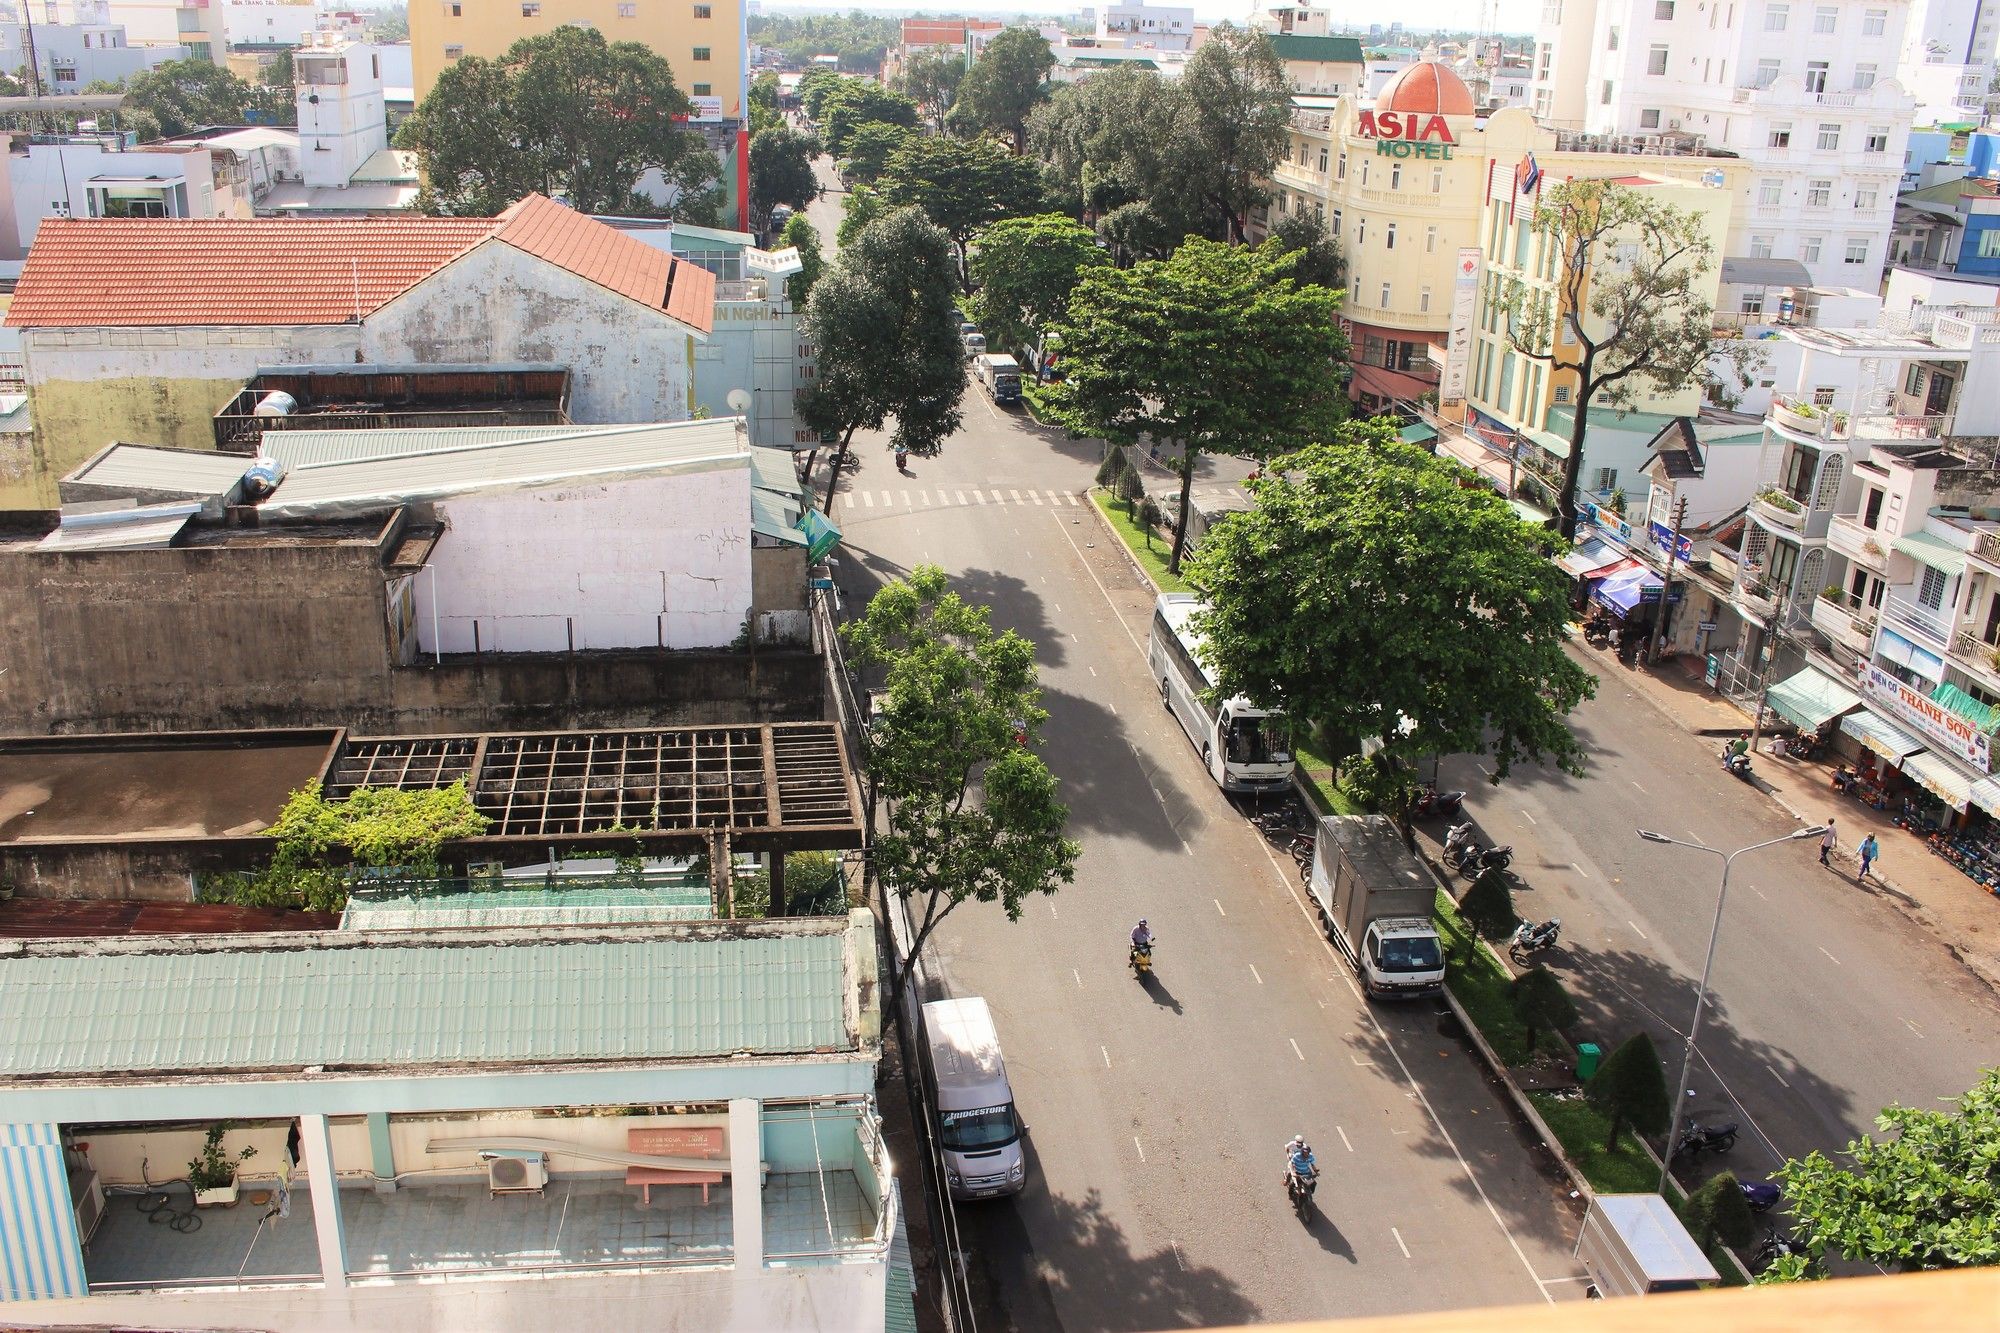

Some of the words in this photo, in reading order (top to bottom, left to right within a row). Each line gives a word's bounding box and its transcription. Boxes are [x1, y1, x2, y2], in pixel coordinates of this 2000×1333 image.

[1358, 110, 1454, 142] ASIA
[1377, 140, 1453, 160] HOTEL
[1946, 716, 1972, 742] SƠN
[944, 1105, 1007, 1121] BRIDGESTONE
